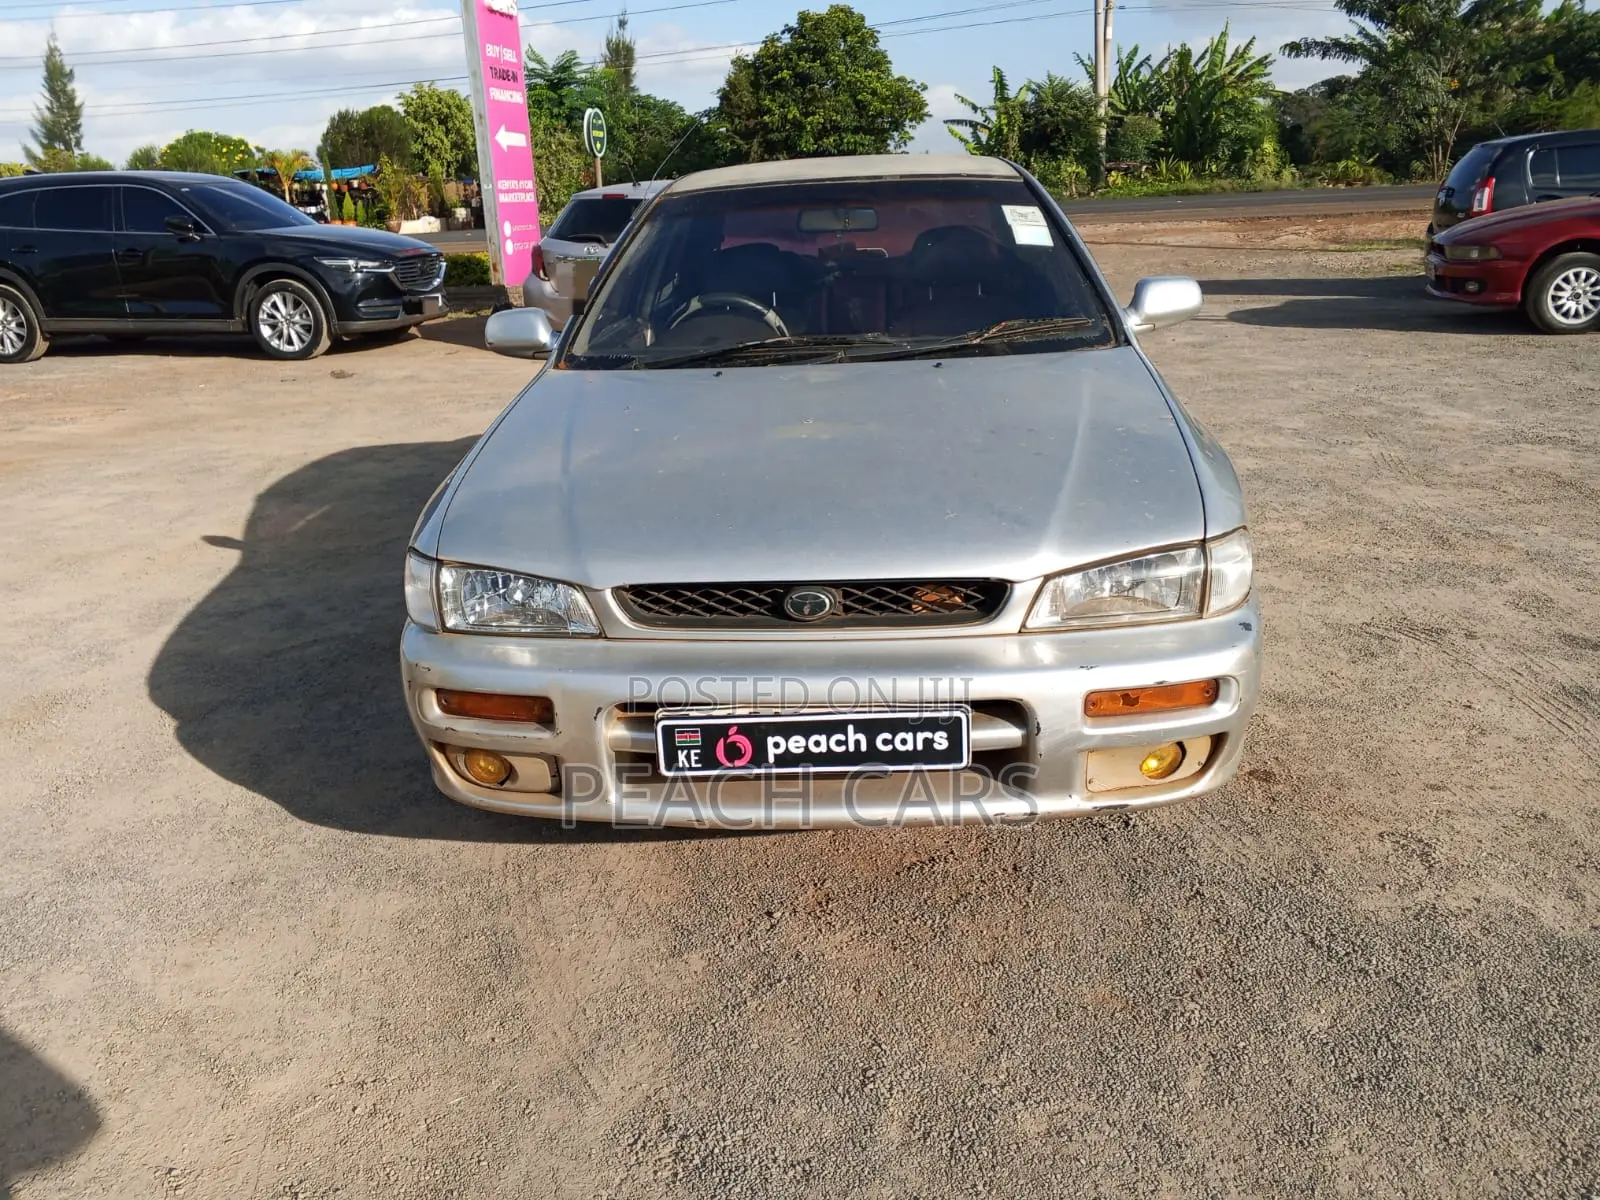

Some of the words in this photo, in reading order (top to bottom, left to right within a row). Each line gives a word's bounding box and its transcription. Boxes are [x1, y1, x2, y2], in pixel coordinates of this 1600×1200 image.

[485, 43, 500, 58] BUY
[503, 47, 518, 63] SELL
[489, 87, 524, 104] FINANCING
[766, 724, 867, 764] peach
[875, 730, 949, 752] cars
[677, 749, 702, 768] KE
